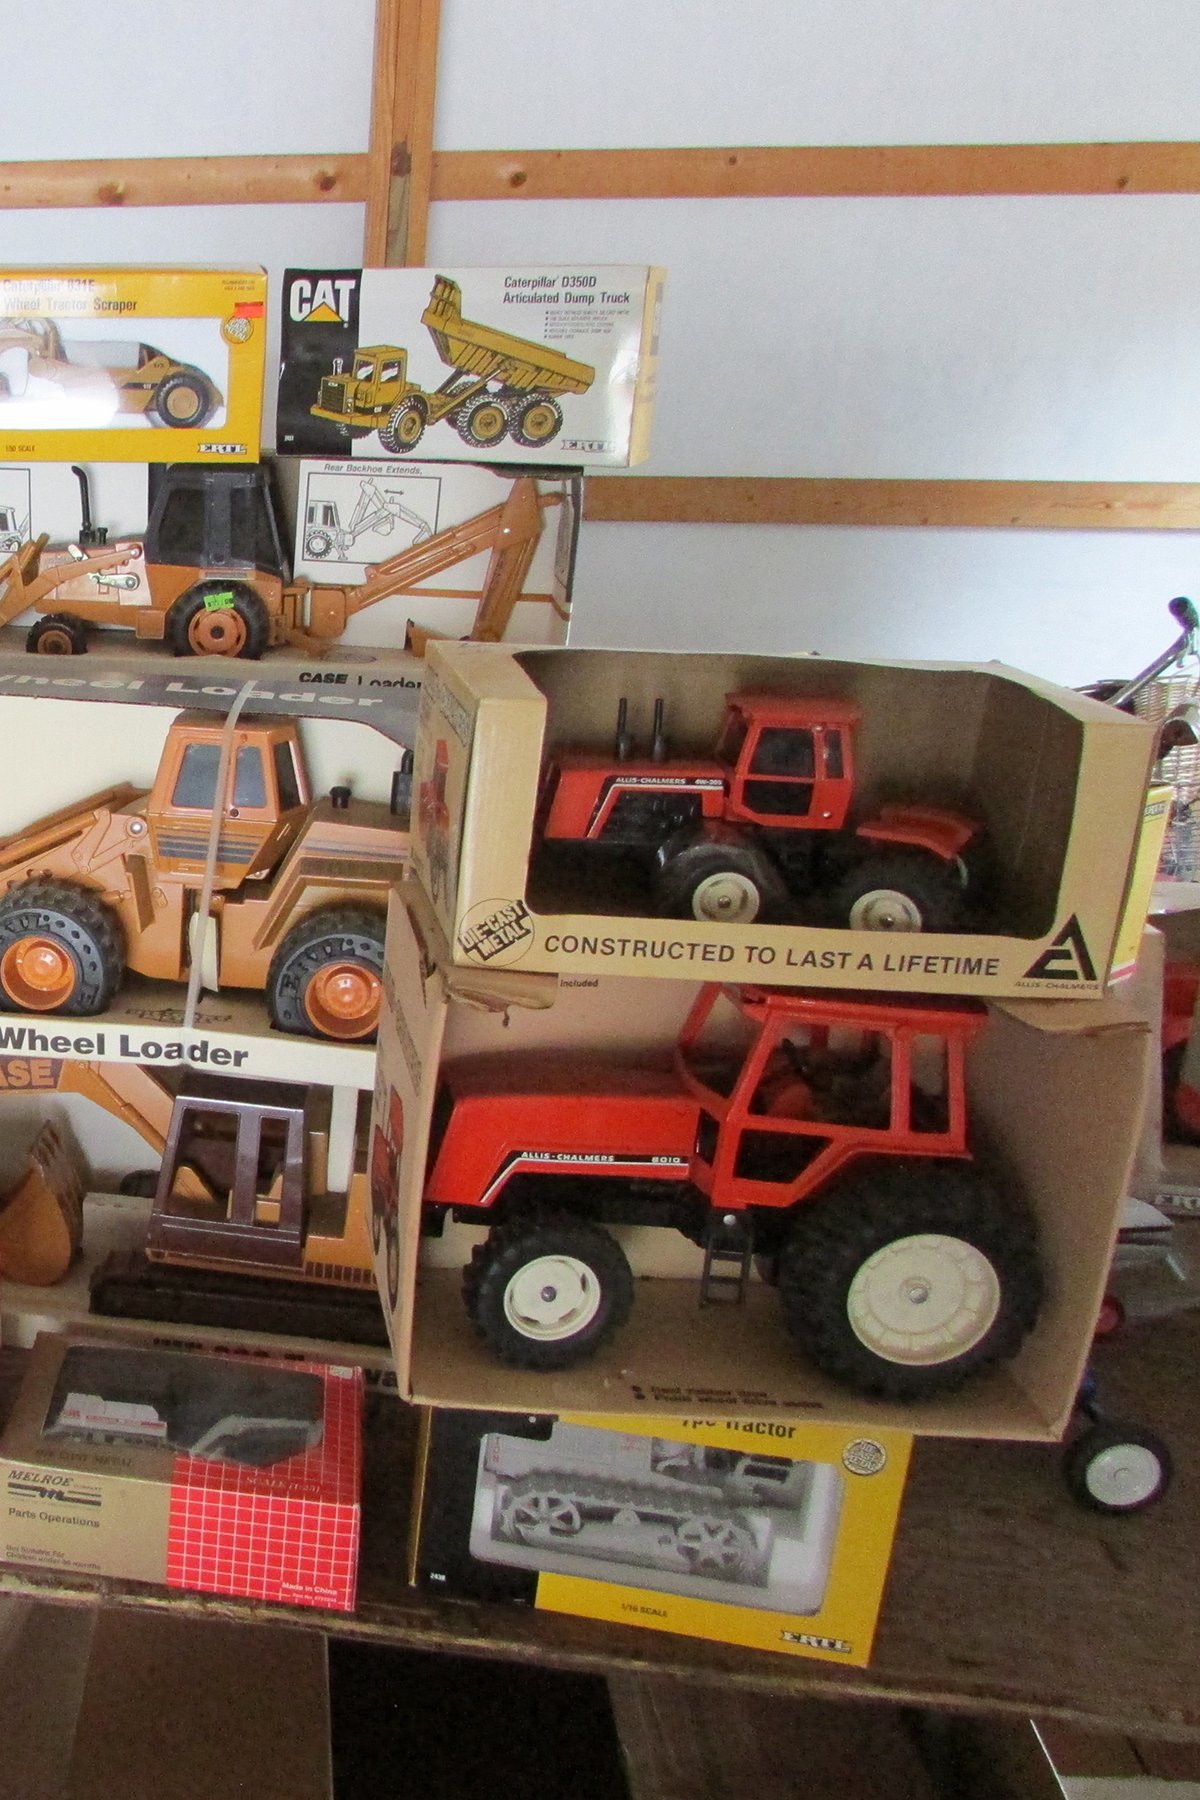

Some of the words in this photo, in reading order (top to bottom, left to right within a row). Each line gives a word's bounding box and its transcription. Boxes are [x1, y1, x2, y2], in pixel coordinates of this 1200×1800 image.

[504, 276, 556, 291] Caterpillar
[561, 276, 597, 288] D350D
[47, 298, 87, 311] Tractor
[94, 298, 137, 314] Scraper
[289, 279, 356, 324] CAT
[503, 292, 559, 304] Articulated
[564, 292, 595, 306] Dump
[600, 292, 630, 304] Truck
[198, 443, 247, 455] ERTL
[324, 463, 344, 473] Rear
[346, 464, 384, 474] Backhoe
[298, 672, 349, 685] CASE
[166, 681, 384, 708] Loader
[615, 776, 686, 785] ALLIS-CHALMERS
[477, 920, 531, 961] METAL
[544, 934, 735, 963] CONSTRUCTED
[745, 944, 777, 965] TO
[786, 948, 852, 971] LAST
[857, 953, 875, 971] A
[883, 953, 1000, 977] LIFETIME
[119, 1033, 249, 1068] Loader
[651, 1156, 681, 1164] 8010
[8, 1469, 74, 1487] MELROE
[8, 1507, 37, 1520] Parts
[39, 1510, 101, 1528] Operations
[282, 1582, 304, 1591] Made
[314, 1586, 338, 1595] China
[640, 1605, 669, 1618] SCALE
[779, 1629, 852, 1654] ERTL
